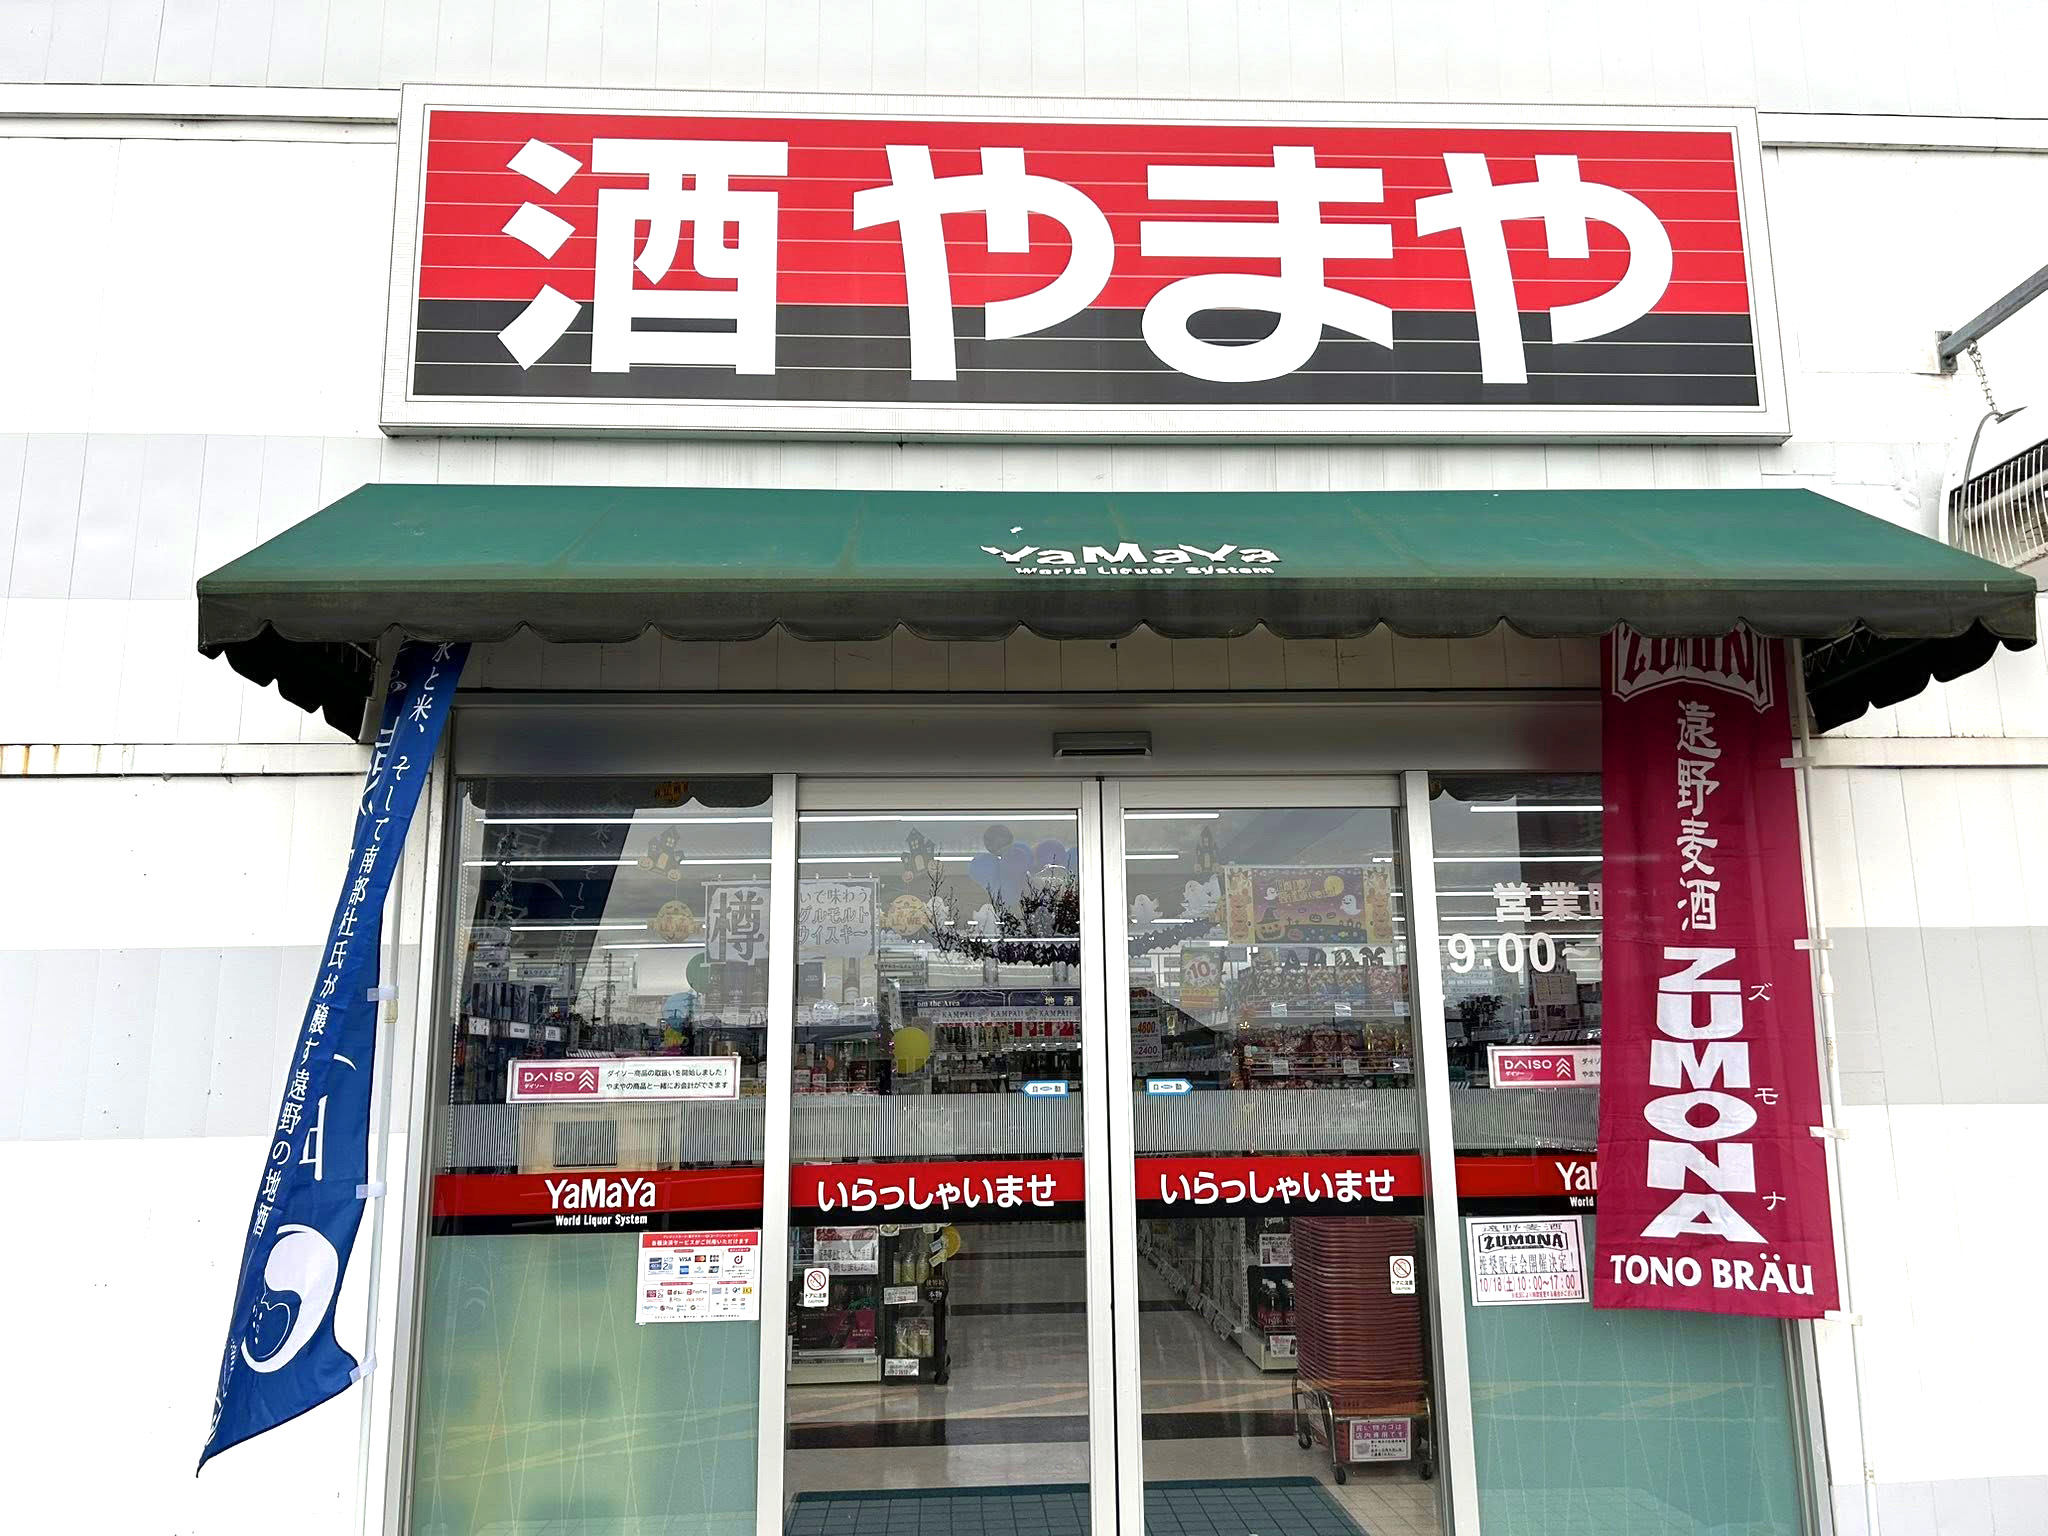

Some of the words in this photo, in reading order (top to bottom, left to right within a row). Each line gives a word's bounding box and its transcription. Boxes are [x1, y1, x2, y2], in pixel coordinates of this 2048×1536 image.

[497, 137, 789, 376] 酒
[852, 144, 1674, 384] やまや
[979, 541, 1282, 565] YaMaYa
[1014, 566, 1087, 576] World
[1186, 566, 1275, 576] System
[1676, 699, 1722, 931] 遠野麦酒
[710, 889, 765, 963] 樽
[524, 1071, 575, 1082] DAISO
[1504, 1059, 1552, 1070] DAISO
[1639, 946, 1770, 1245] ZUMONA
[545, 1177, 657, 1210] YaMaYa
[816, 1173, 1057, 1213] いらっしゃいませ
[1160, 1169, 1395, 1205] いらっしゃいませ
[1570, 1196, 1594, 1208] World
[555, 1214, 581, 1226] World
[583, 1213, 611, 1227] Liquor
[614, 1213, 648, 1227] System
[1483, 1233, 1564, 1250] ZUMONA
[1609, 1253, 1702, 1288] TONO
